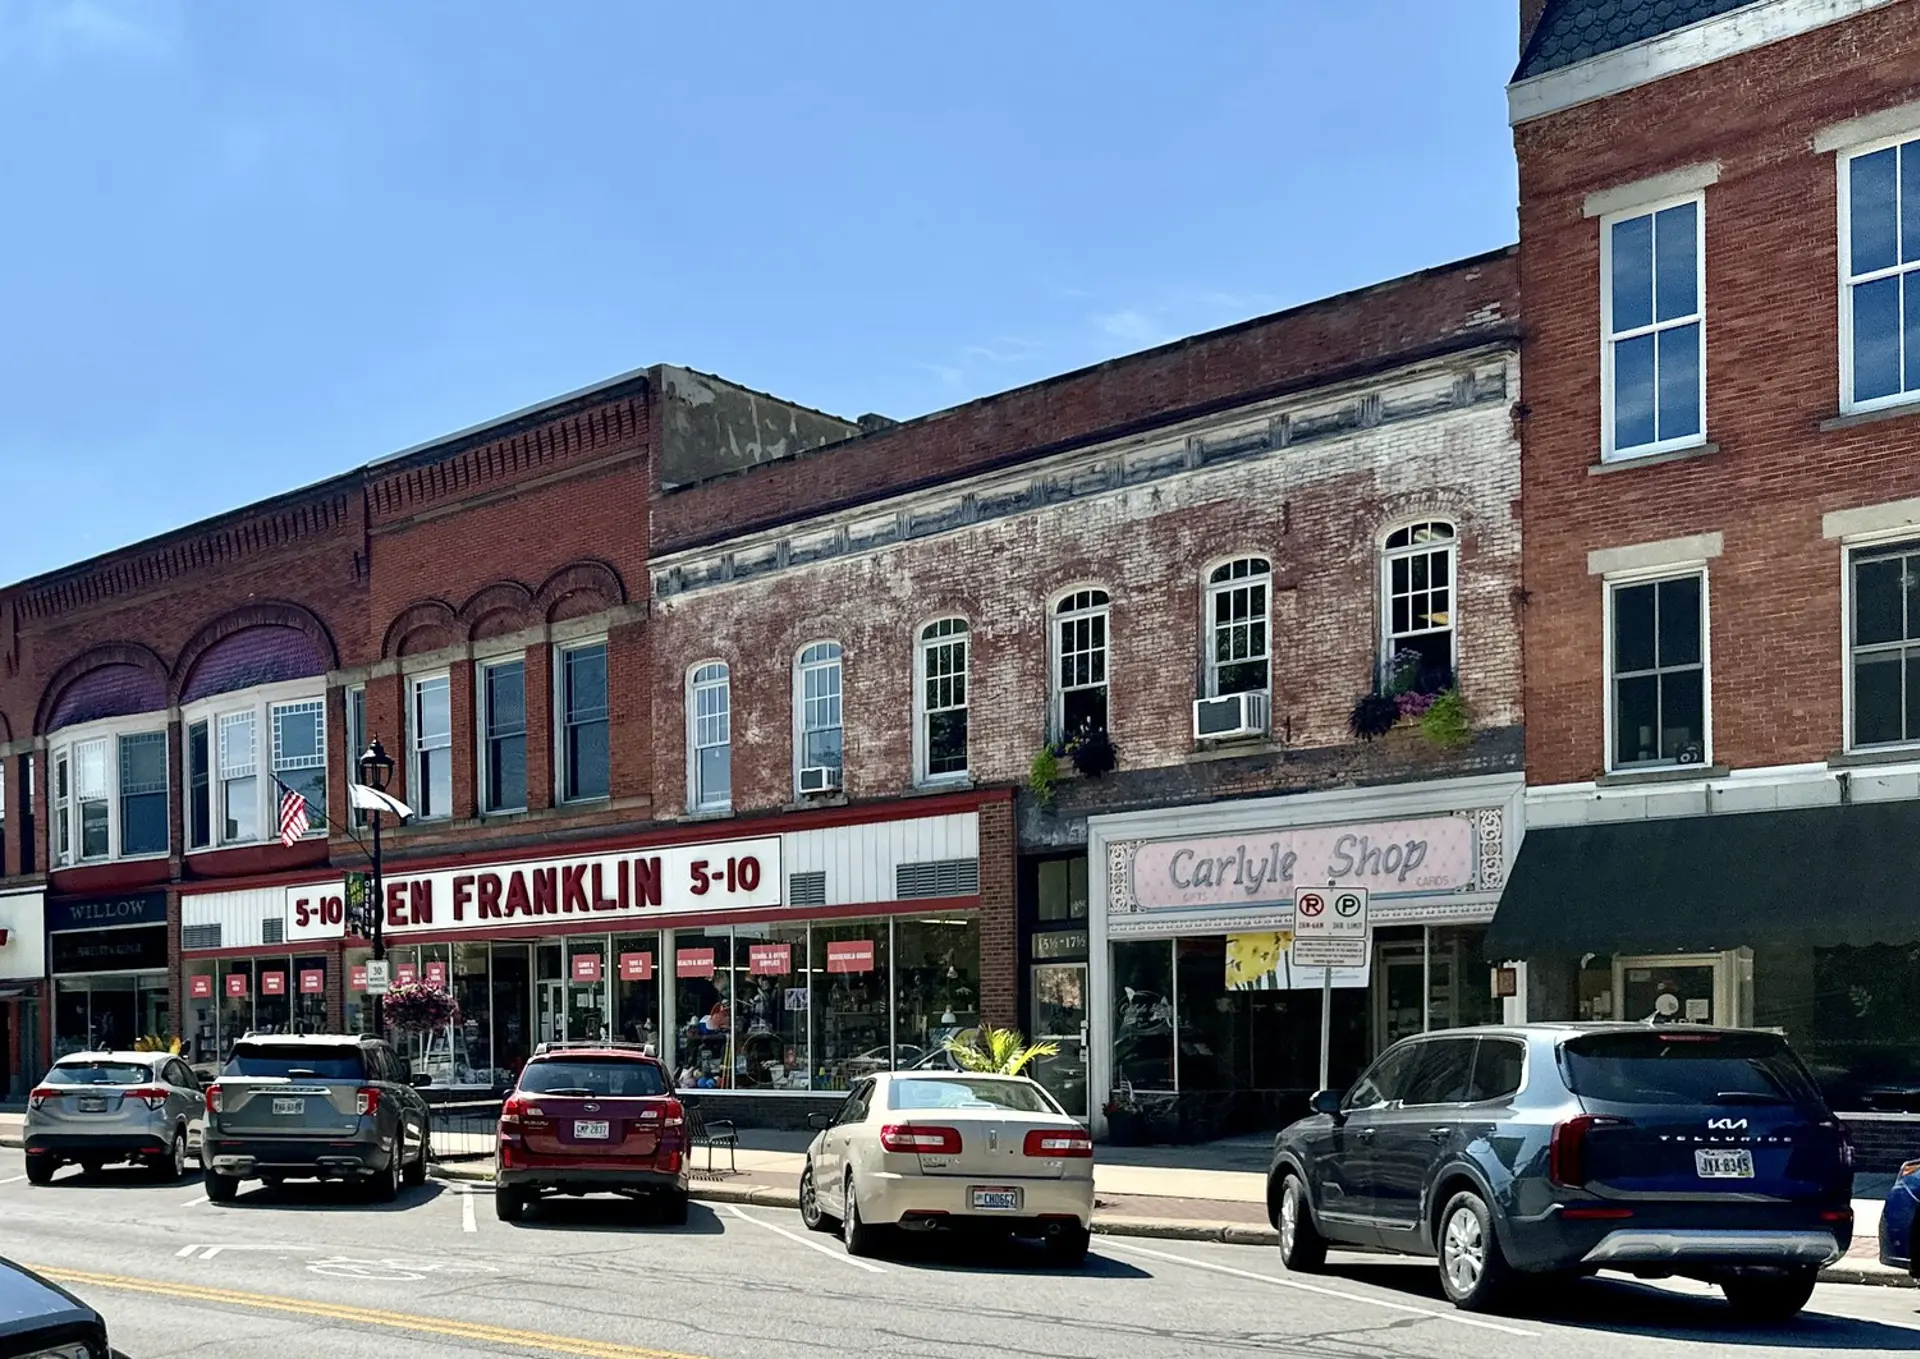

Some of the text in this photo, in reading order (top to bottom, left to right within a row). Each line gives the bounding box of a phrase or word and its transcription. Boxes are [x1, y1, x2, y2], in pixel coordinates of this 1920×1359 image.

[1168, 833, 1428, 895] Carlyle Shop
[1416, 875, 1449, 888] CARDS
[296, 896, 343, 928] 5-10
[387, 879, 433, 927] EN
[453, 855, 761, 921] FRANKLIN 5-10
[69, 899, 147, 921] WILLOW
[1707, 1118, 1748, 1130] KIA
